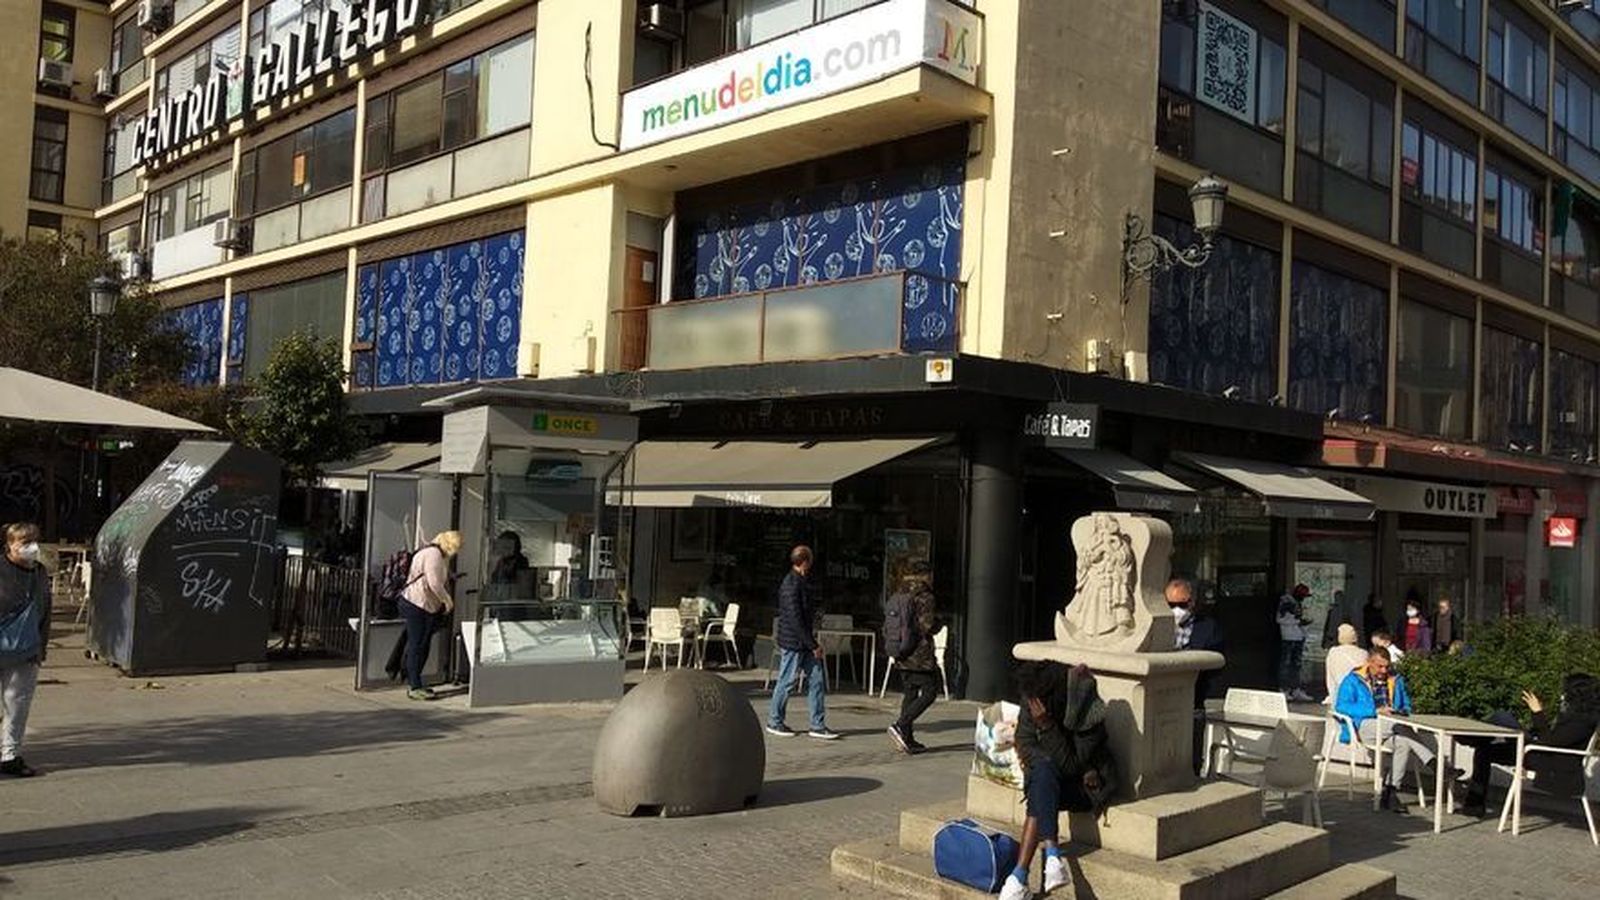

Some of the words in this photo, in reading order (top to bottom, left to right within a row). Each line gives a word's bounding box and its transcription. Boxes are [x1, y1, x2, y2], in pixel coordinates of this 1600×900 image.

[131, 72, 220, 166] CENTRO
[252, 0, 421, 105] GALLEGO
[641, 27, 902, 133] menudeldia.com
[551, 418, 593, 433] ONCE
[1024, 413, 1051, 437] Café
[1051, 413, 1060, 437] &
[1061, 414, 1092, 438] Tapas
[1424, 487, 1487, 514] OUTLET
